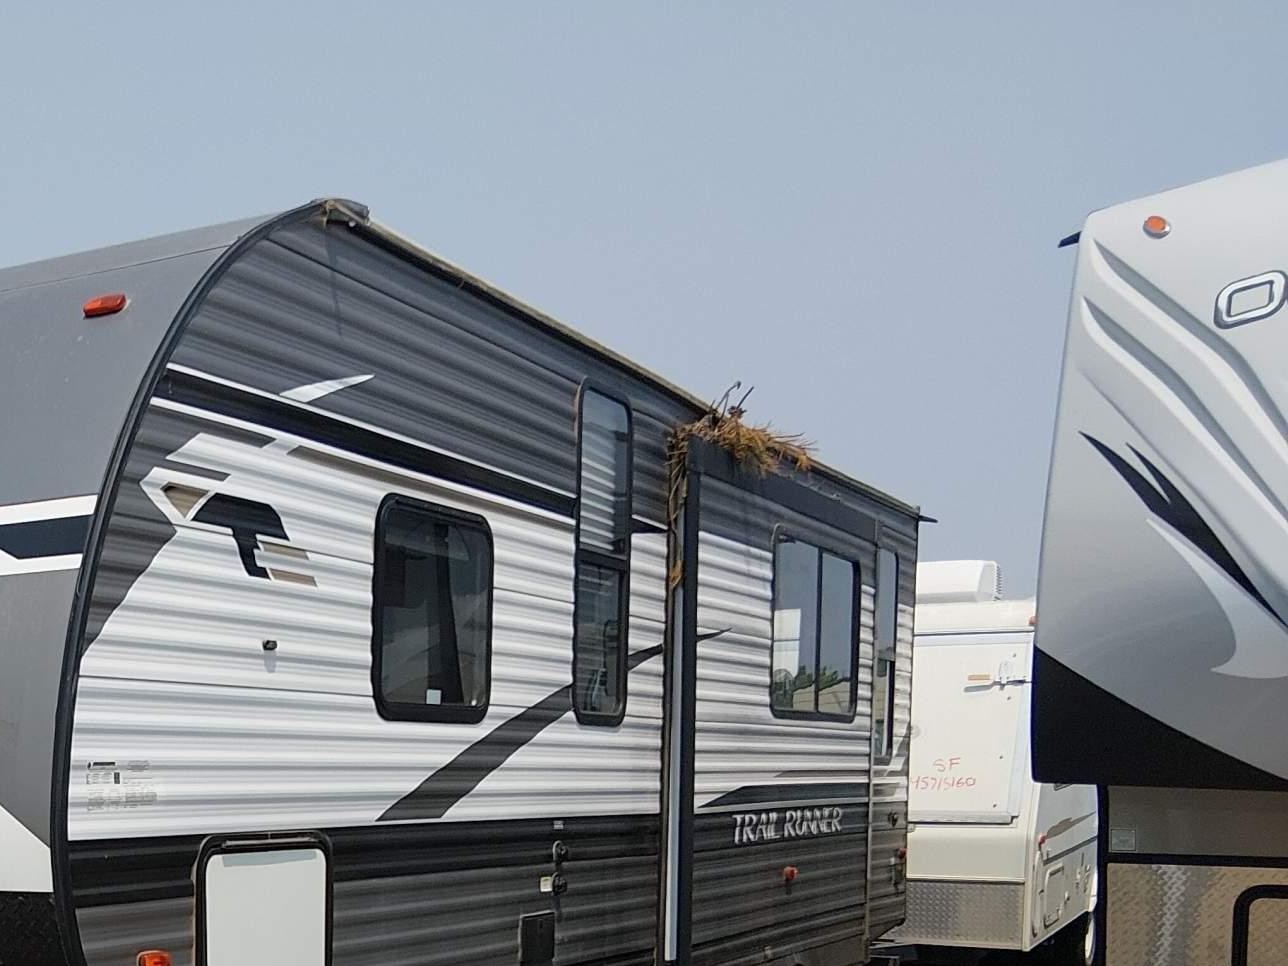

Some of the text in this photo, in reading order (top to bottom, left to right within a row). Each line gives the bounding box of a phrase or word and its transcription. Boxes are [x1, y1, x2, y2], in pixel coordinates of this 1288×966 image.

[933, 757, 961, 772] SF
[732, 806, 842, 845] TRAIL RUNNER
